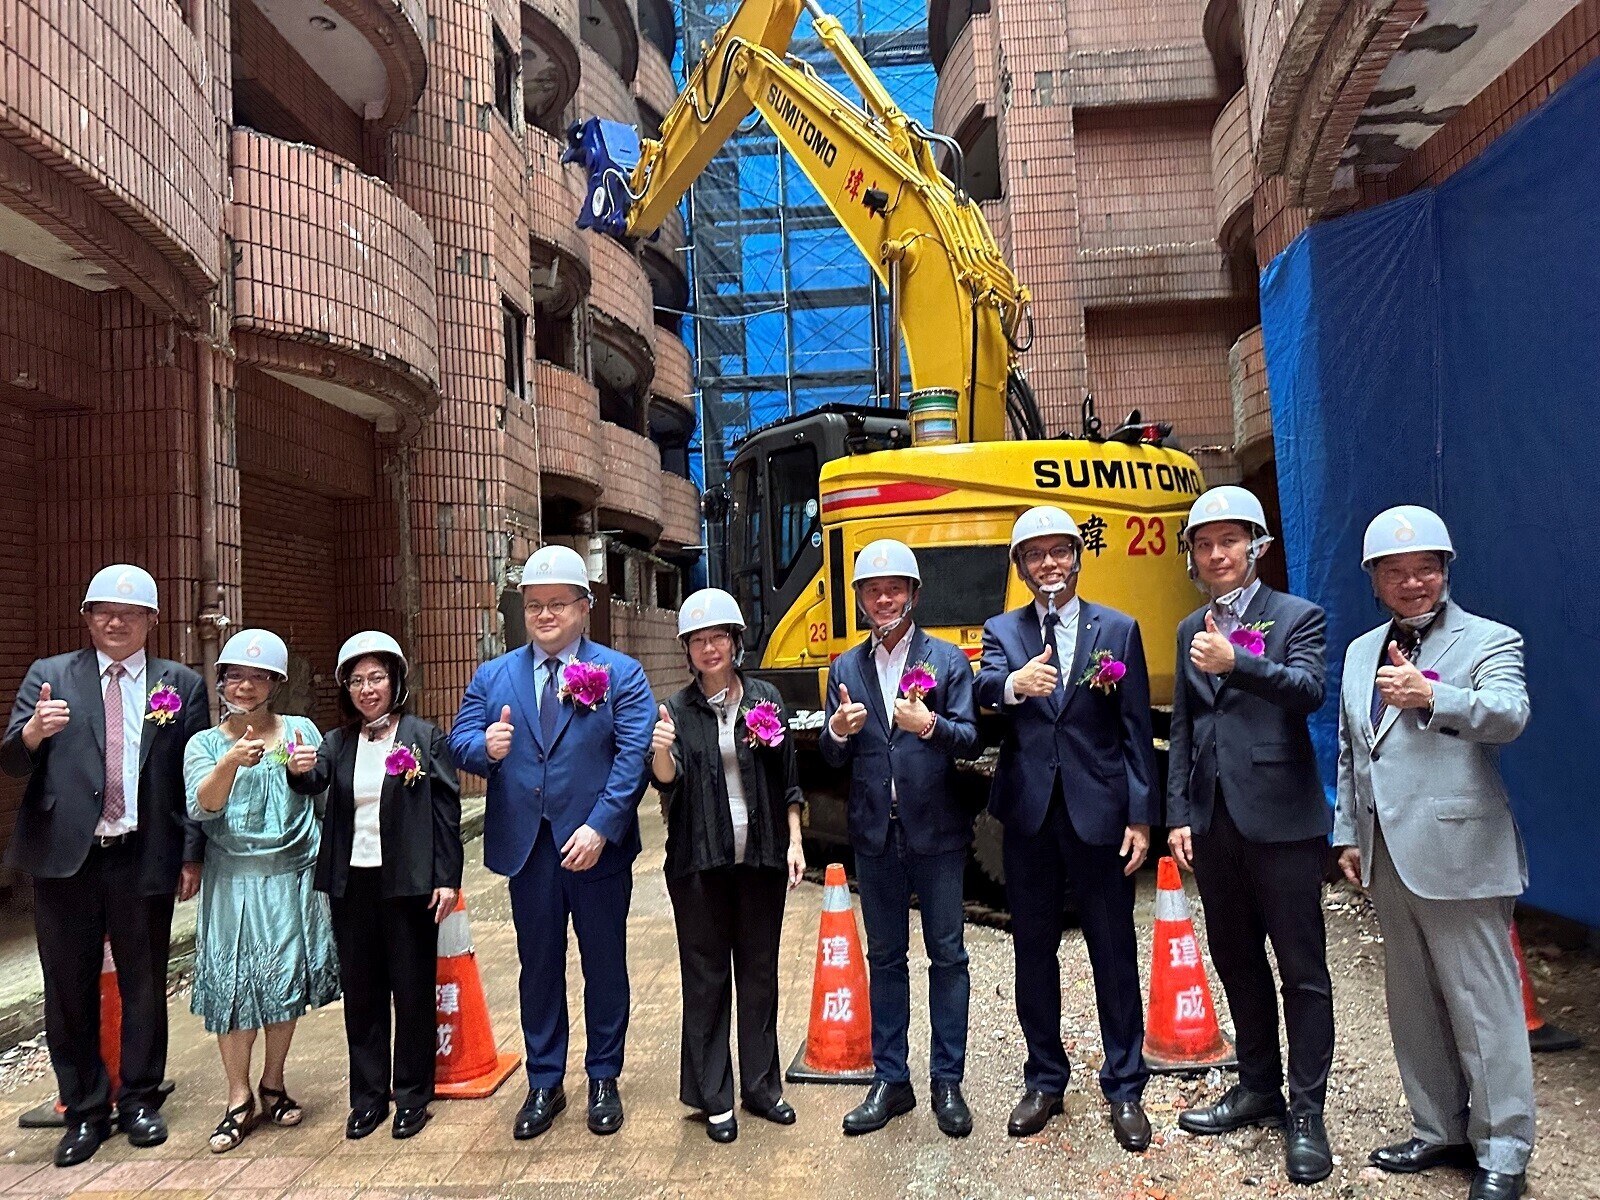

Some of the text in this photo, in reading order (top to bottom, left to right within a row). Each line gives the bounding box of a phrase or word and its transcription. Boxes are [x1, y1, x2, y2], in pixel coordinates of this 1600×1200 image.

[767, 82, 837, 169] SUMITOMO
[1033, 459, 1201, 494] SUMITOMO
[1126, 516, 1166, 556] 23
[810, 622, 828, 642] 23
